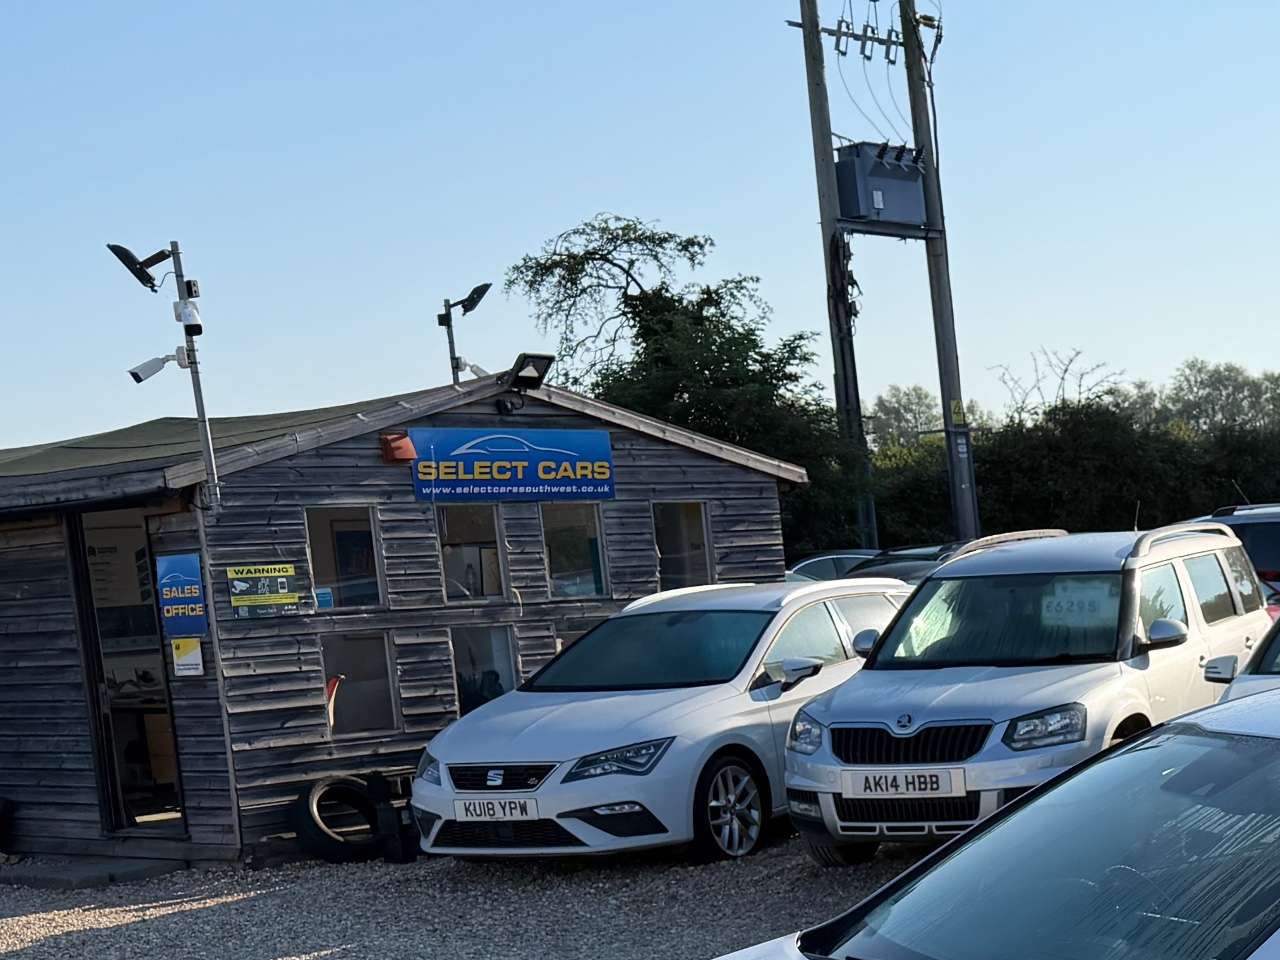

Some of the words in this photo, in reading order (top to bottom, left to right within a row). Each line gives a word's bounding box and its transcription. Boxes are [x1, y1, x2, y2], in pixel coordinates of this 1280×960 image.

[417, 461, 529, 481] SELECT
[537, 461, 611, 480] CARS
[421, 484, 610, 495] www.selectcarssouthwest.co.uk
[233, 566, 289, 576] WARNING
[162, 585, 200, 599] SALES
[163, 603, 204, 618] OFFICE
[863, 775, 900, 792] AK14
[904, 774, 940, 791] HBB
[463, 801, 496, 817] KU18
[498, 800, 529, 817] YPW
